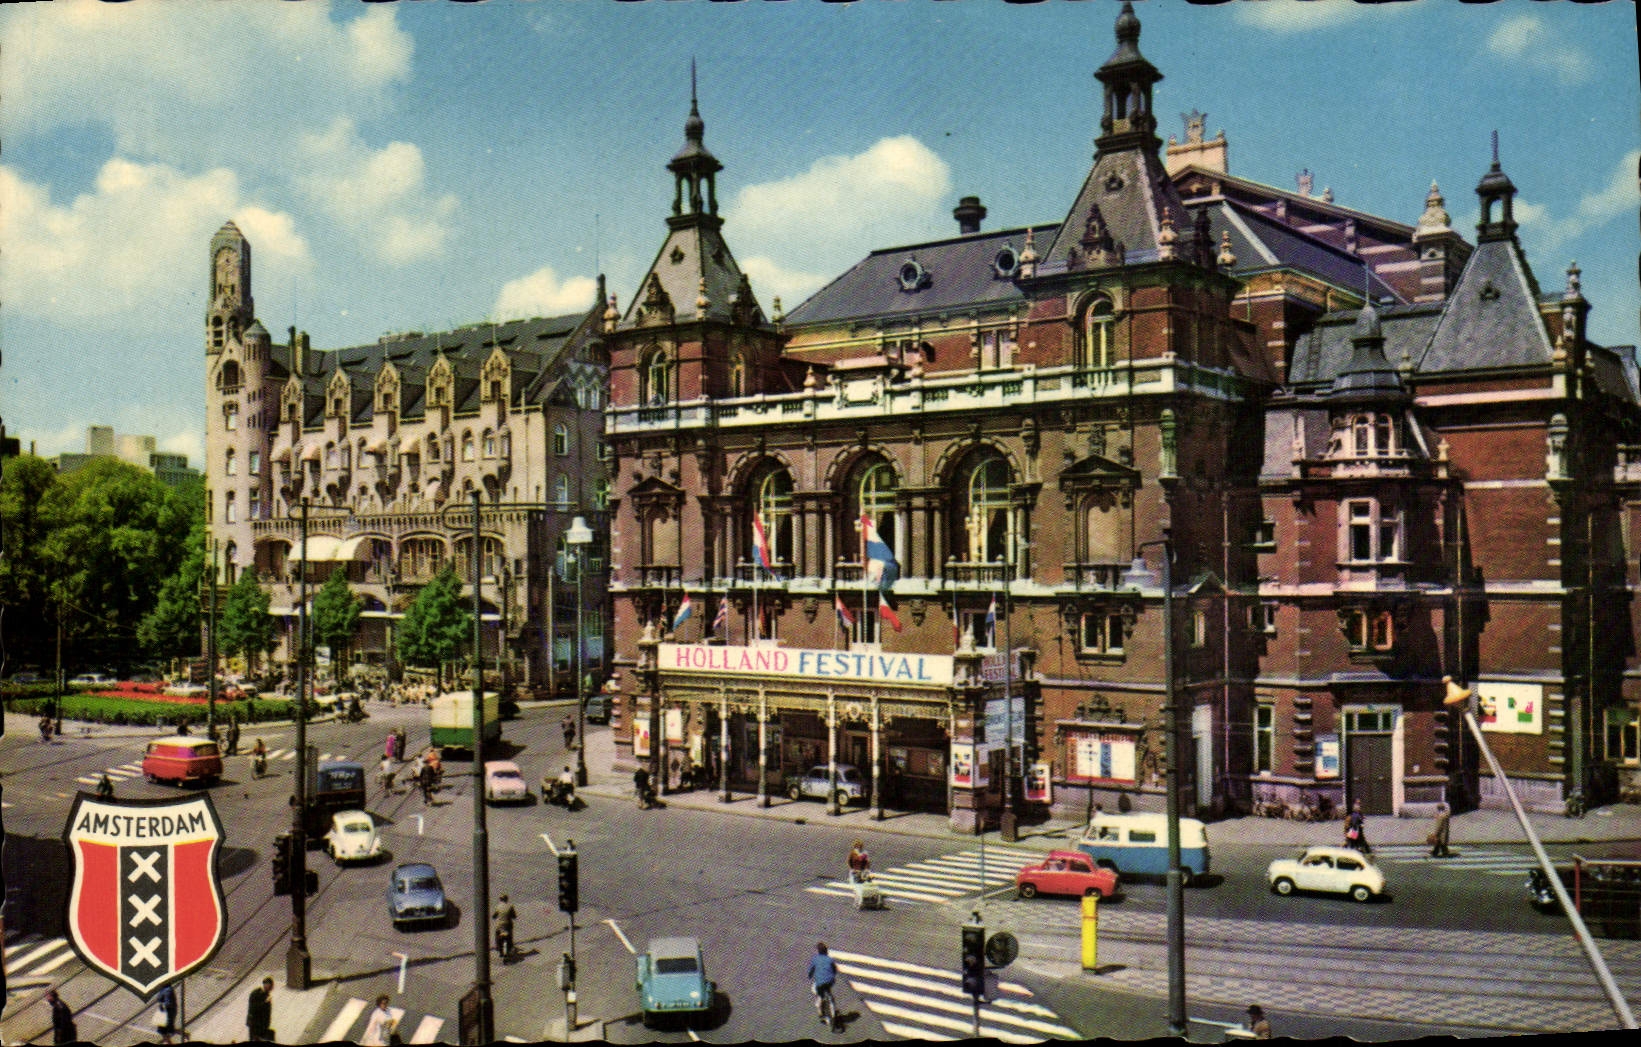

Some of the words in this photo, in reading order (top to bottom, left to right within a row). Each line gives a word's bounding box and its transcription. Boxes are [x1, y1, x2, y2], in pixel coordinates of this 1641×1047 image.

[676, 647, 789, 671] HOLLAND
[799, 651, 932, 680] FESTIVAL
[984, 668, 1017, 680] FESTIL
